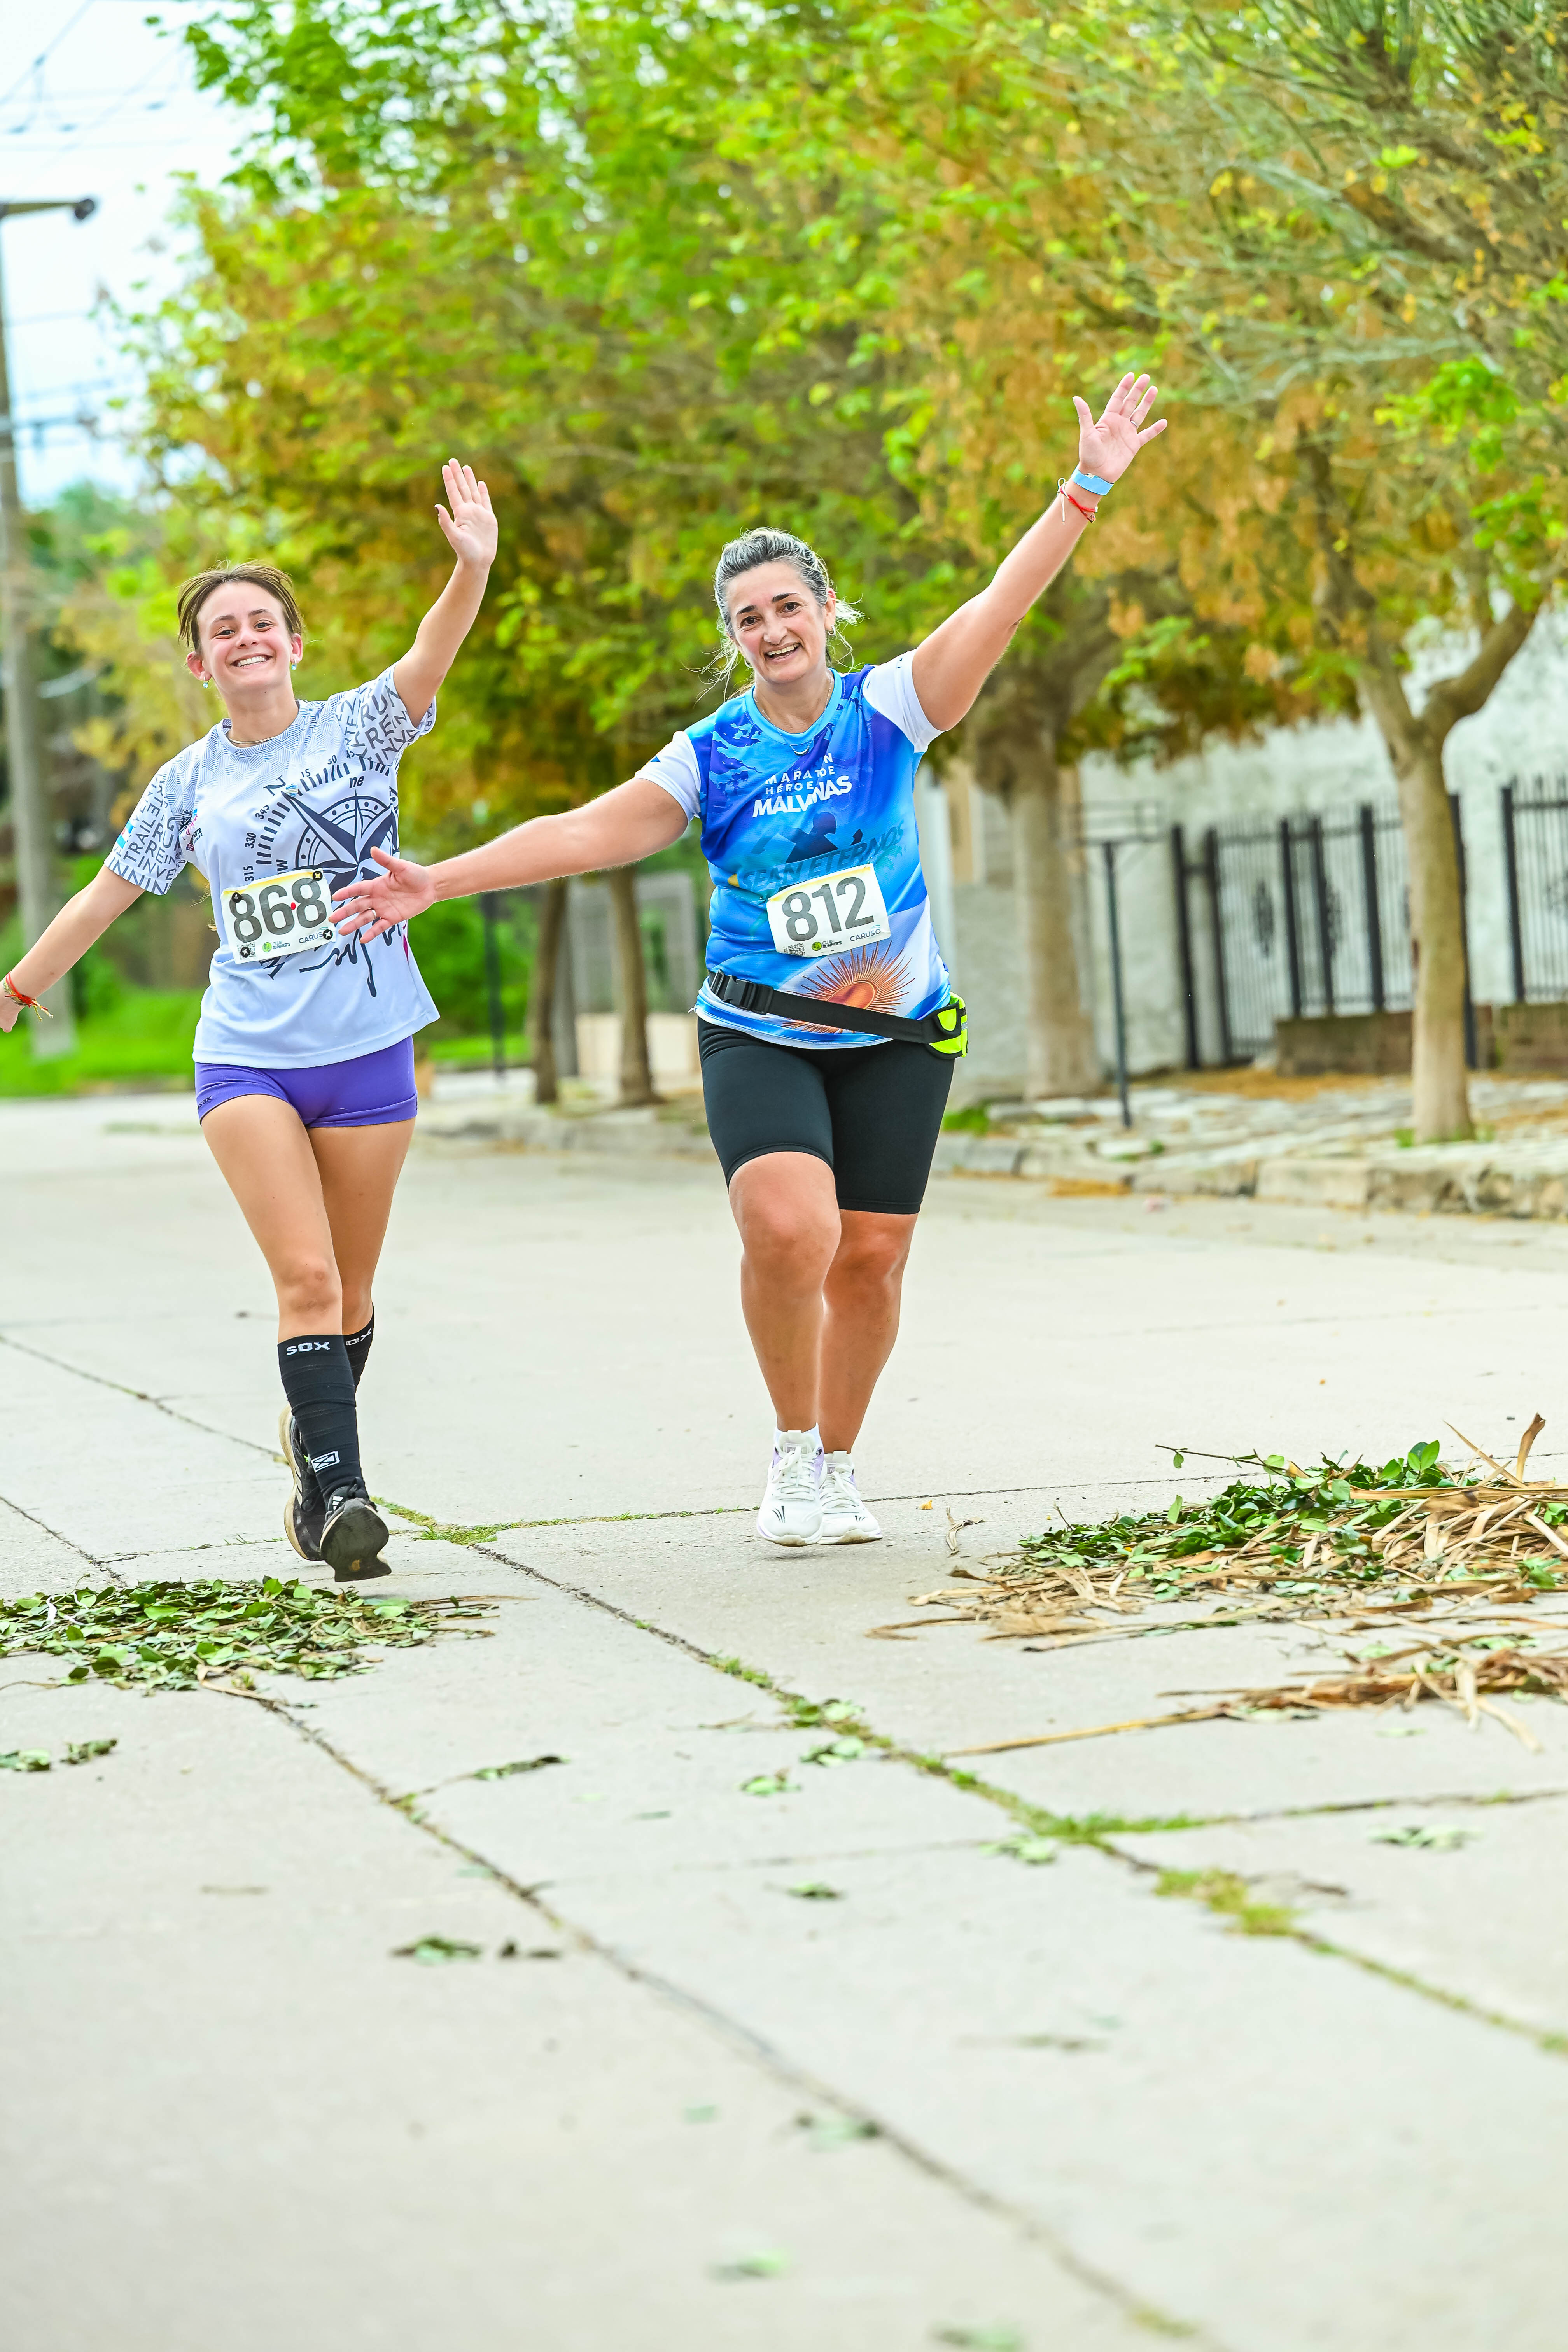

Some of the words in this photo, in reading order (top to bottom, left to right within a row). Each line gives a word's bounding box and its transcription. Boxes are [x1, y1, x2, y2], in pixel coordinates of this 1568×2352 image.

[327, 755, 337, 765] 30
[301, 768, 311, 778] 15
[765, 781, 814, 795] HÉROE
[123, 819, 156, 862] TRAIL
[244, 832, 257, 849] 330
[243, 865, 254, 882] 315
[229, 878, 327, 943] 868
[782, 877, 874, 942] 812
[299, 931, 326, 944] CARUS
[850, 929, 881, 942] CARUSO
[346, 1328, 371, 1346] OX
[286, 1342, 330, 1356] SOX
